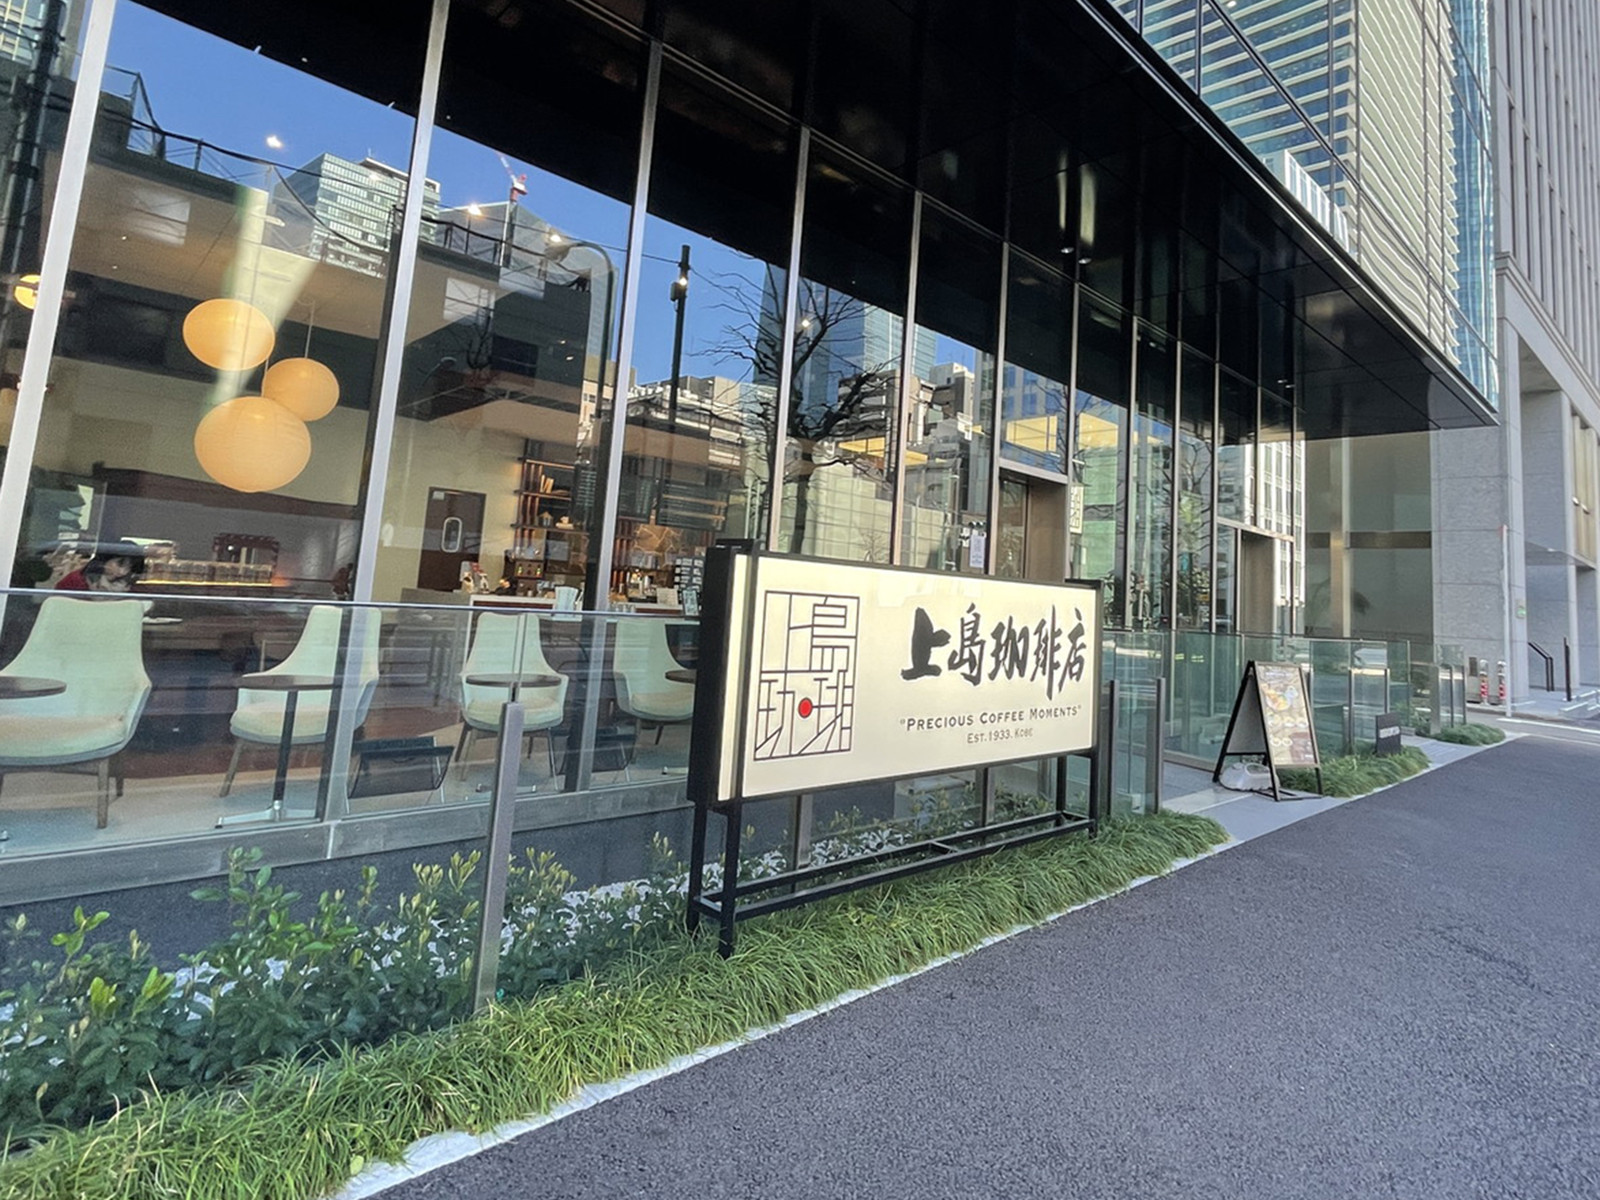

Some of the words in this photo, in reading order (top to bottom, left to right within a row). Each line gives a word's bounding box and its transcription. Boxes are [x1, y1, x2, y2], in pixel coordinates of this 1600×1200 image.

[900, 602, 1087, 701] 上島珈琲店
[979, 710, 1025, 724] COFFEE
